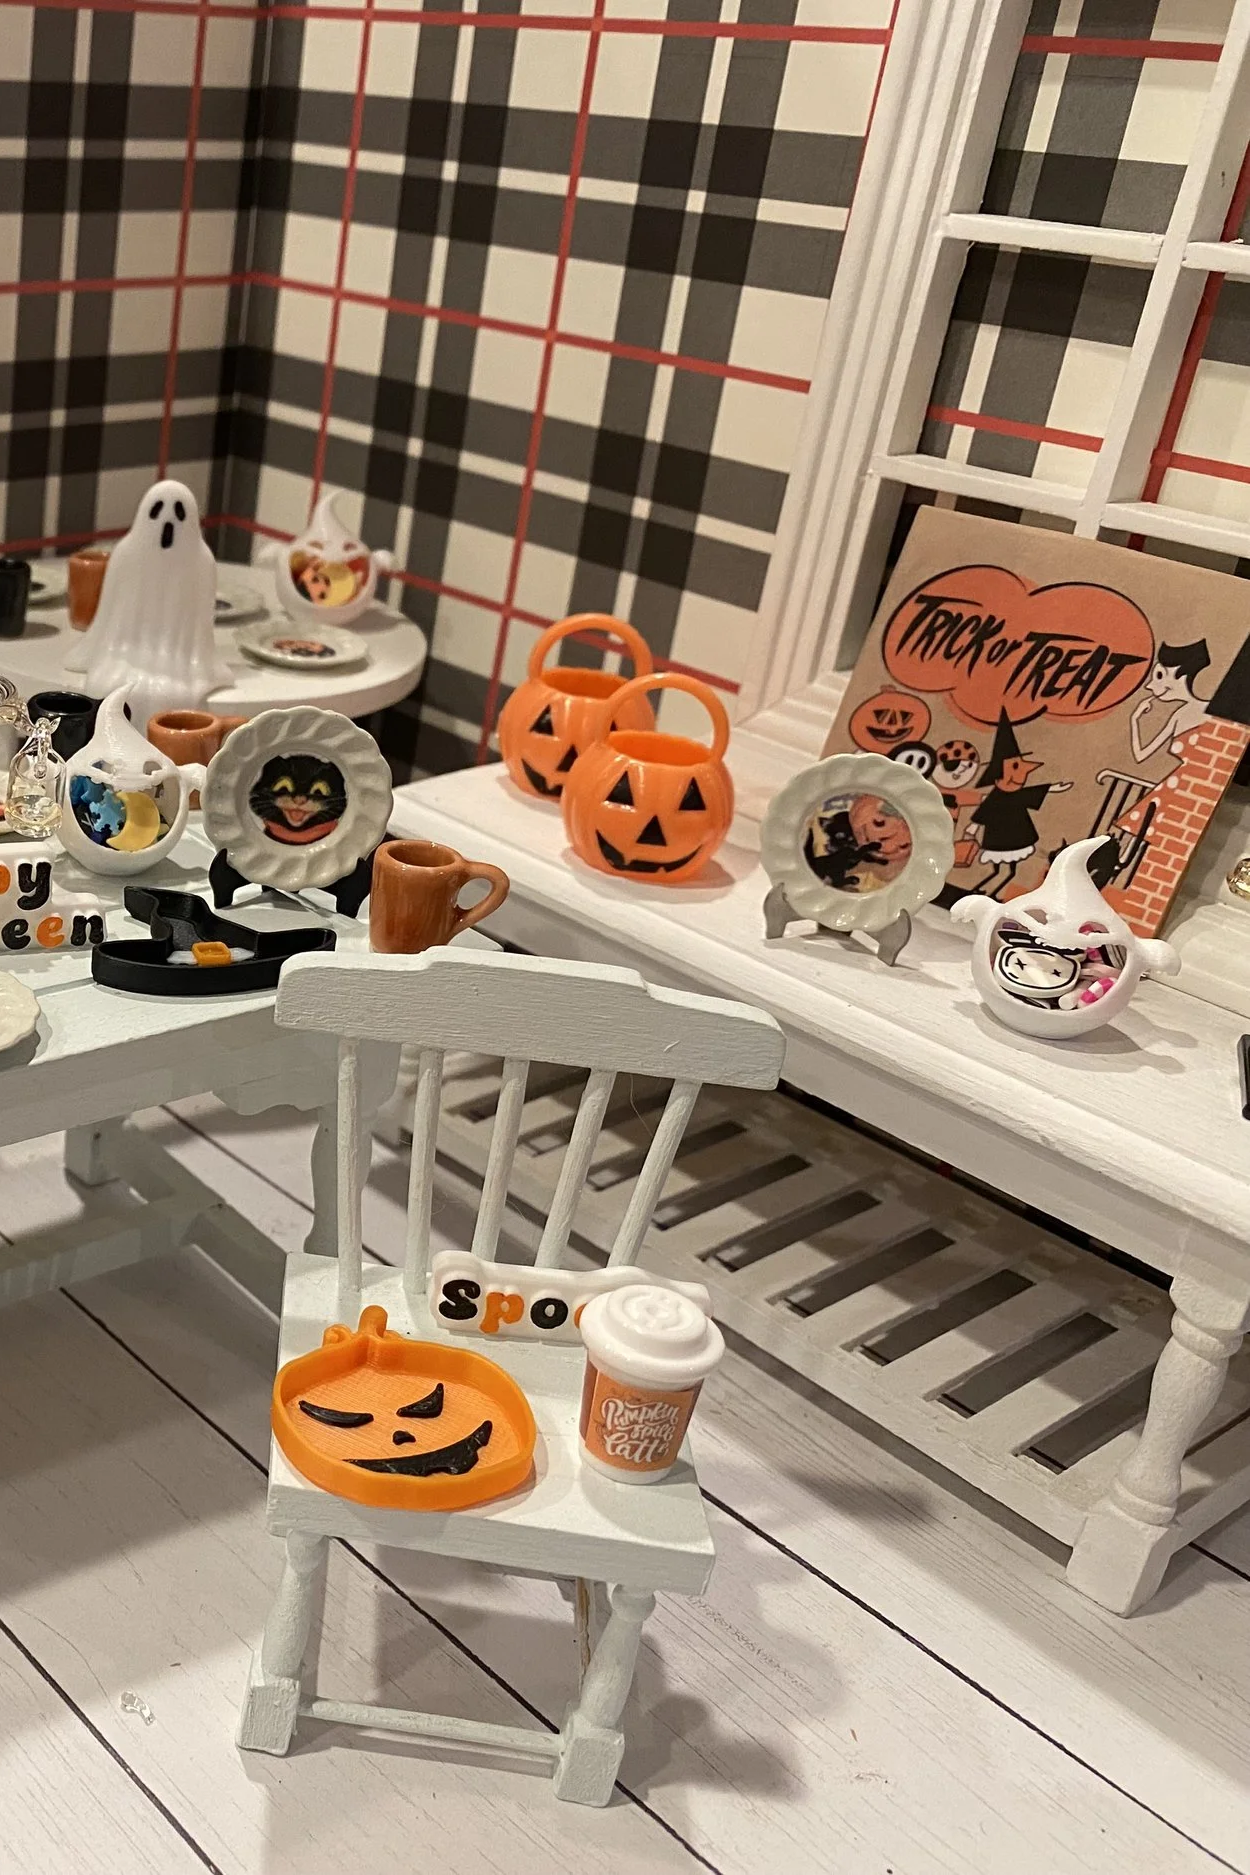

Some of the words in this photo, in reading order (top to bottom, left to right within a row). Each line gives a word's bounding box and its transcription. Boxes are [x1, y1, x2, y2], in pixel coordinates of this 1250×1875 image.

[895, 594, 1006, 678] TRICK
[986, 636, 1023, 668] or
[1003, 631, 1149, 709] TREAT
[438, 1278, 588, 1334] Spo
[601, 1397, 680, 1431] Pumpkin
